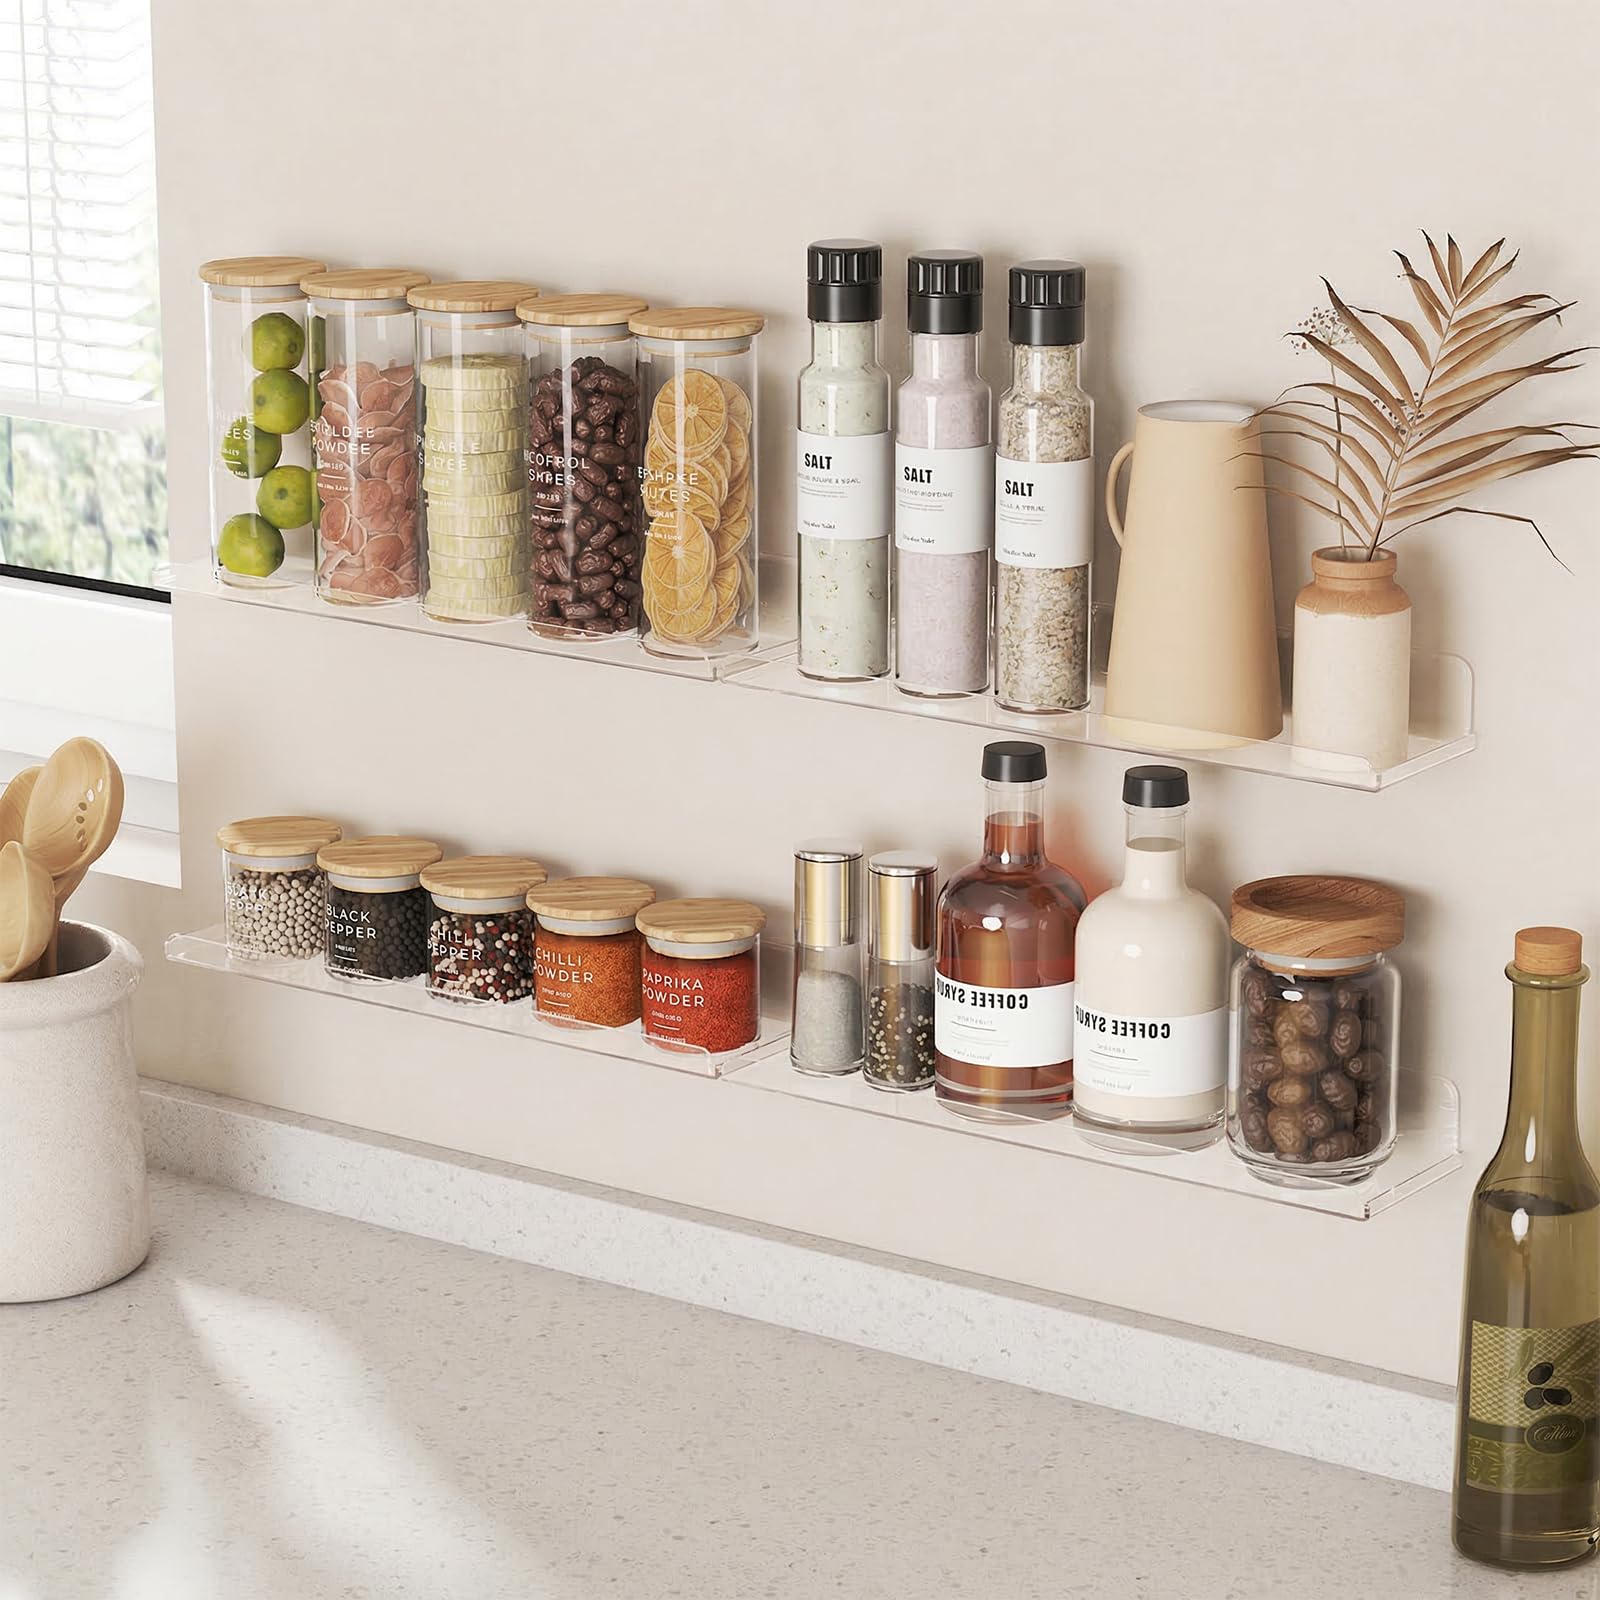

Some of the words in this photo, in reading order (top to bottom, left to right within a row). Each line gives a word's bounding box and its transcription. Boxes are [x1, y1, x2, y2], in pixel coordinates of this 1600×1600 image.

[804, 453, 832, 470] SALT
[904, 466, 933, 484] SALT
[1005, 480, 1034, 497] SALT
[326, 903, 371, 924] BLACK
[324, 918, 377, 939] PEPPER
[535, 947, 582, 967] CHILLI
[533, 960, 593, 983] POWDER
[642, 968, 703, 991] PAPRIKA
[642, 983, 705, 1008] POWDER
